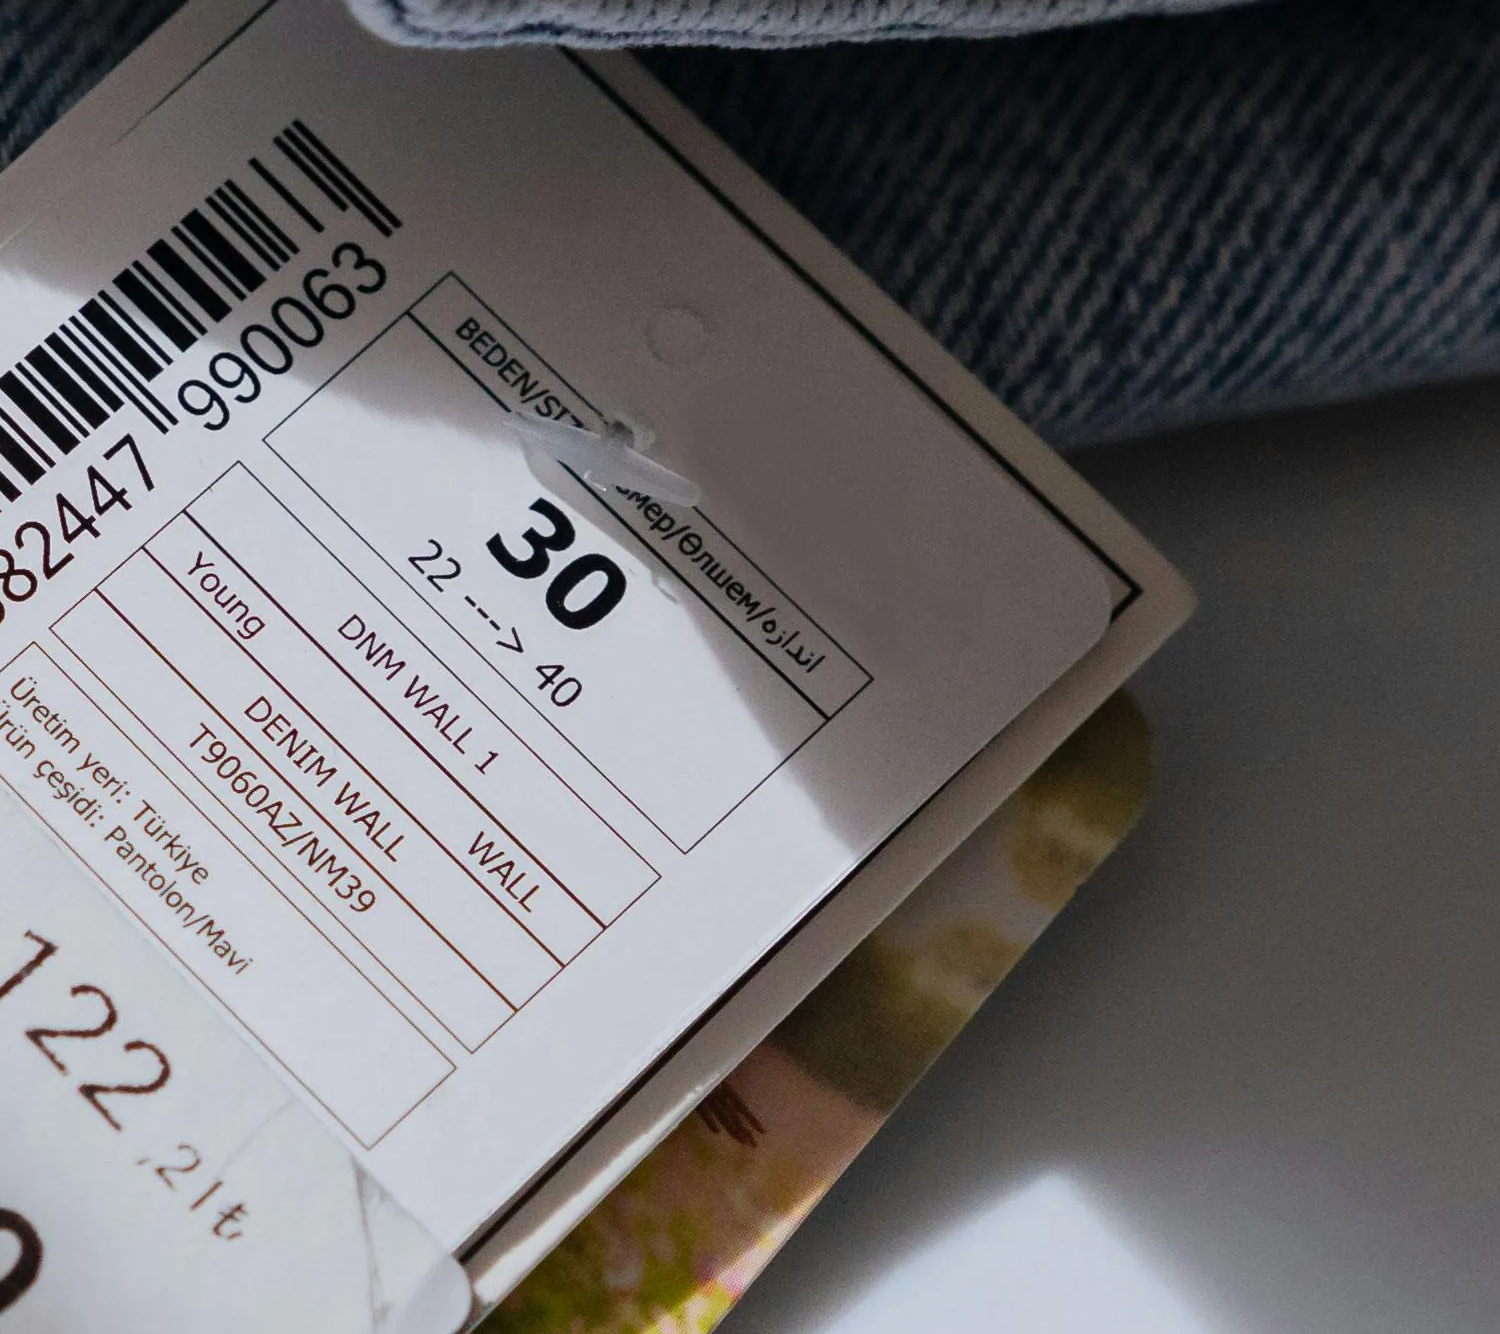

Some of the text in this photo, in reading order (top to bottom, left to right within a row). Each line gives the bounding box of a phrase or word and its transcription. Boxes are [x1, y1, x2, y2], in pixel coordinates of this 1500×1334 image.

[177, 242, 387, 432] 990063
[186, 550, 266, 640] Young
[407, 538, 462, 593] 22
[535, 664, 583, 708] 40
[485, 497, 627, 630] 30
[337, 613, 499, 775] DNM WALL 1
[10, 676, 209, 885] Üretim yeri: Türkiye
[189, 722, 376, 913] T9060AZ/NM39
[243, 695, 405, 863] DENIM WALL
[32, 759, 105, 828] çeşidi:
[103, 824, 254, 975] Pantolon/Mavi
[467, 830, 540, 913] WALL
